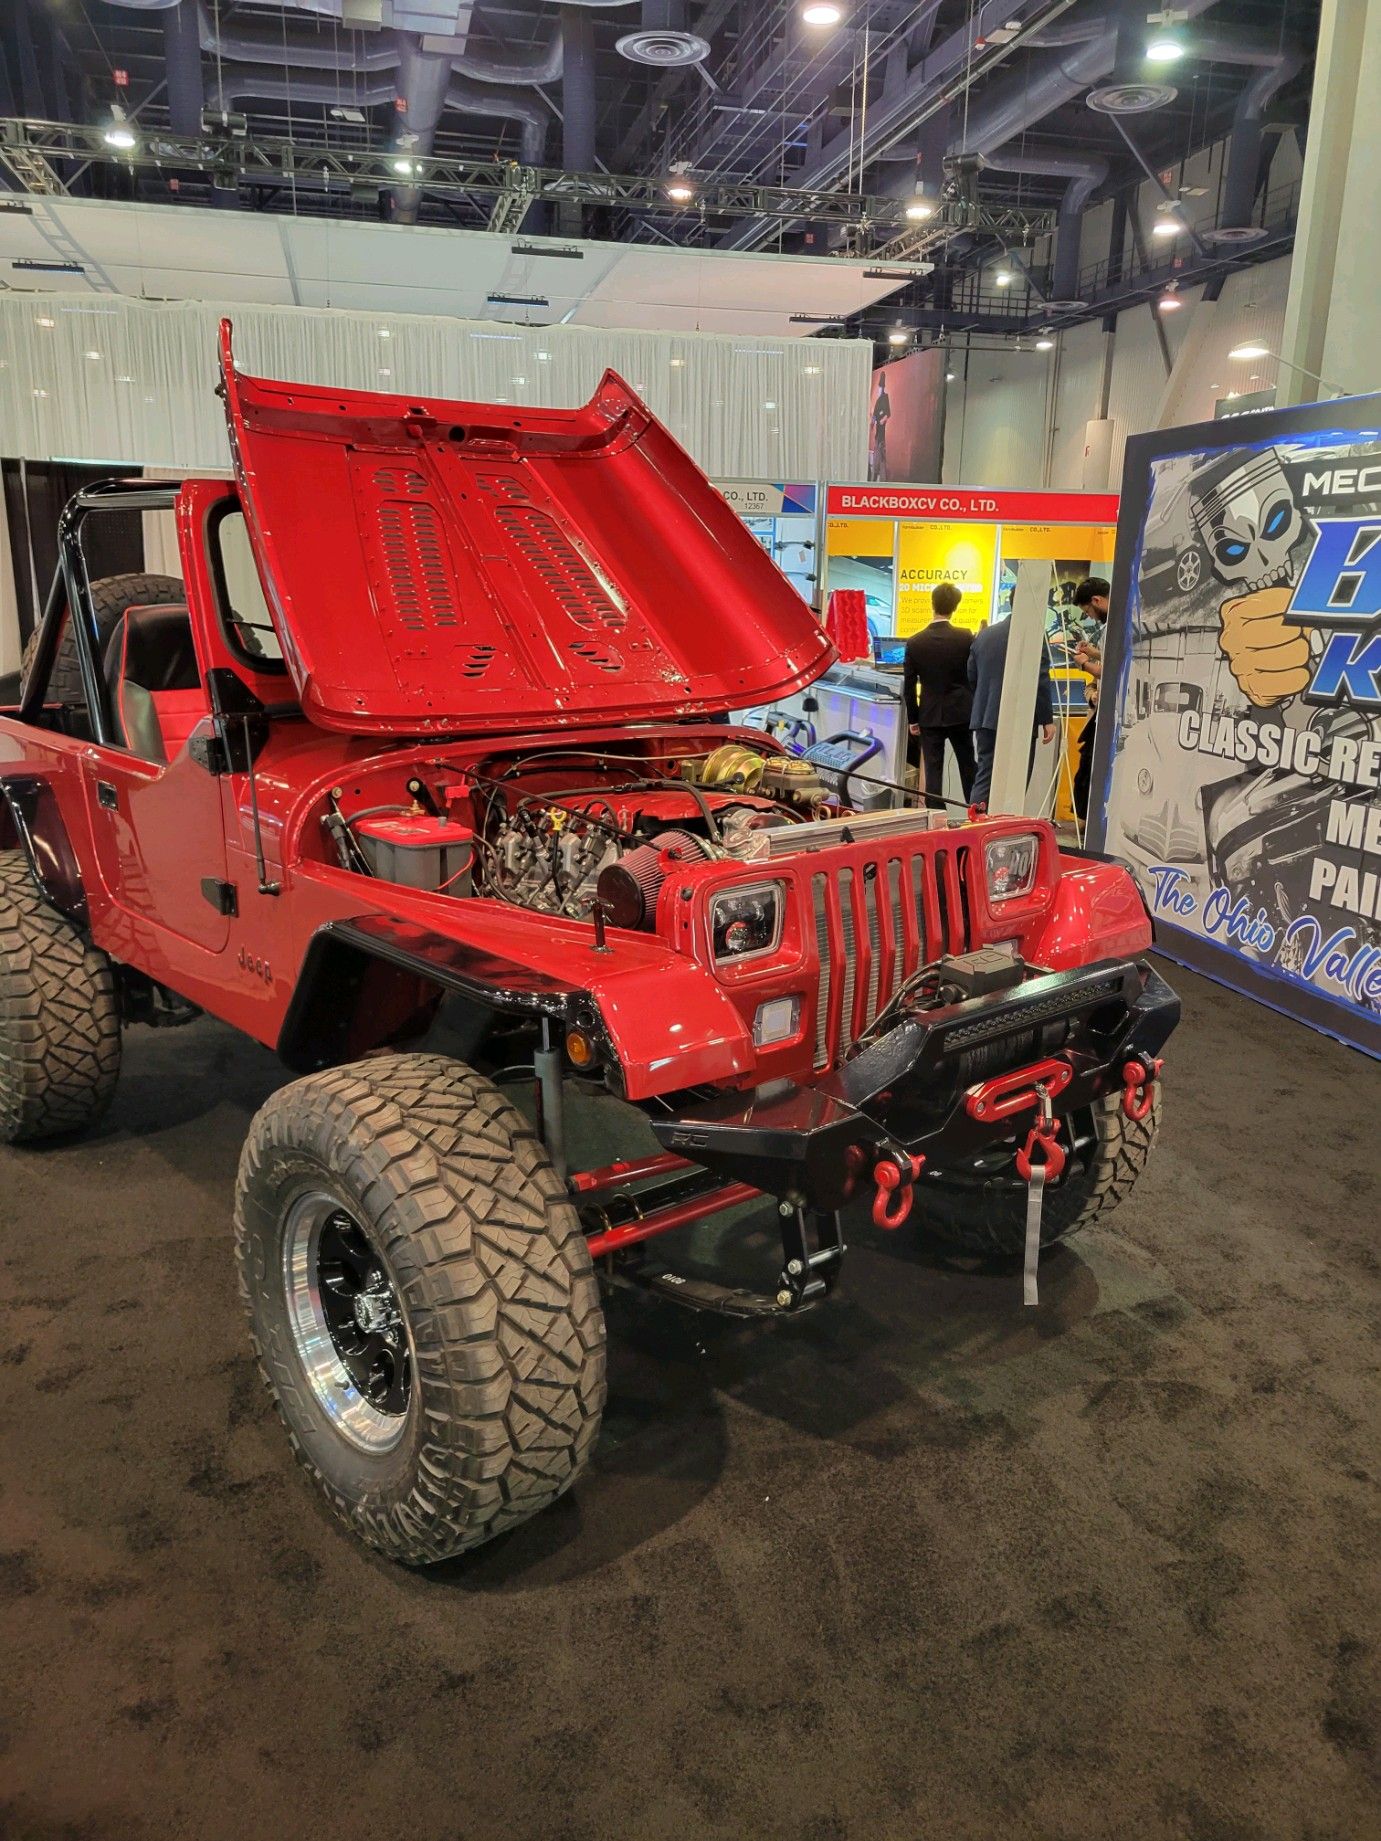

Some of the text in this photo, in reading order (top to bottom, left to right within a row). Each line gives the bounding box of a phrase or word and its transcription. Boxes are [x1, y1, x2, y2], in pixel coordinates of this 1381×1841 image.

[744, 502, 765, 510] 12367
[746, 491, 769, 502] LTD.
[841, 495, 1000, 512] BLACKBOXCV CO., LTD.
[900, 569, 968, 580] ACCURACY
[1178, 709, 1381, 787] CLASSIC RE
[1309, 857, 1381, 921] PAI
[1147, 865, 1381, 1001] The Ohio Valle
[237, 943, 273, 987] Jeep
